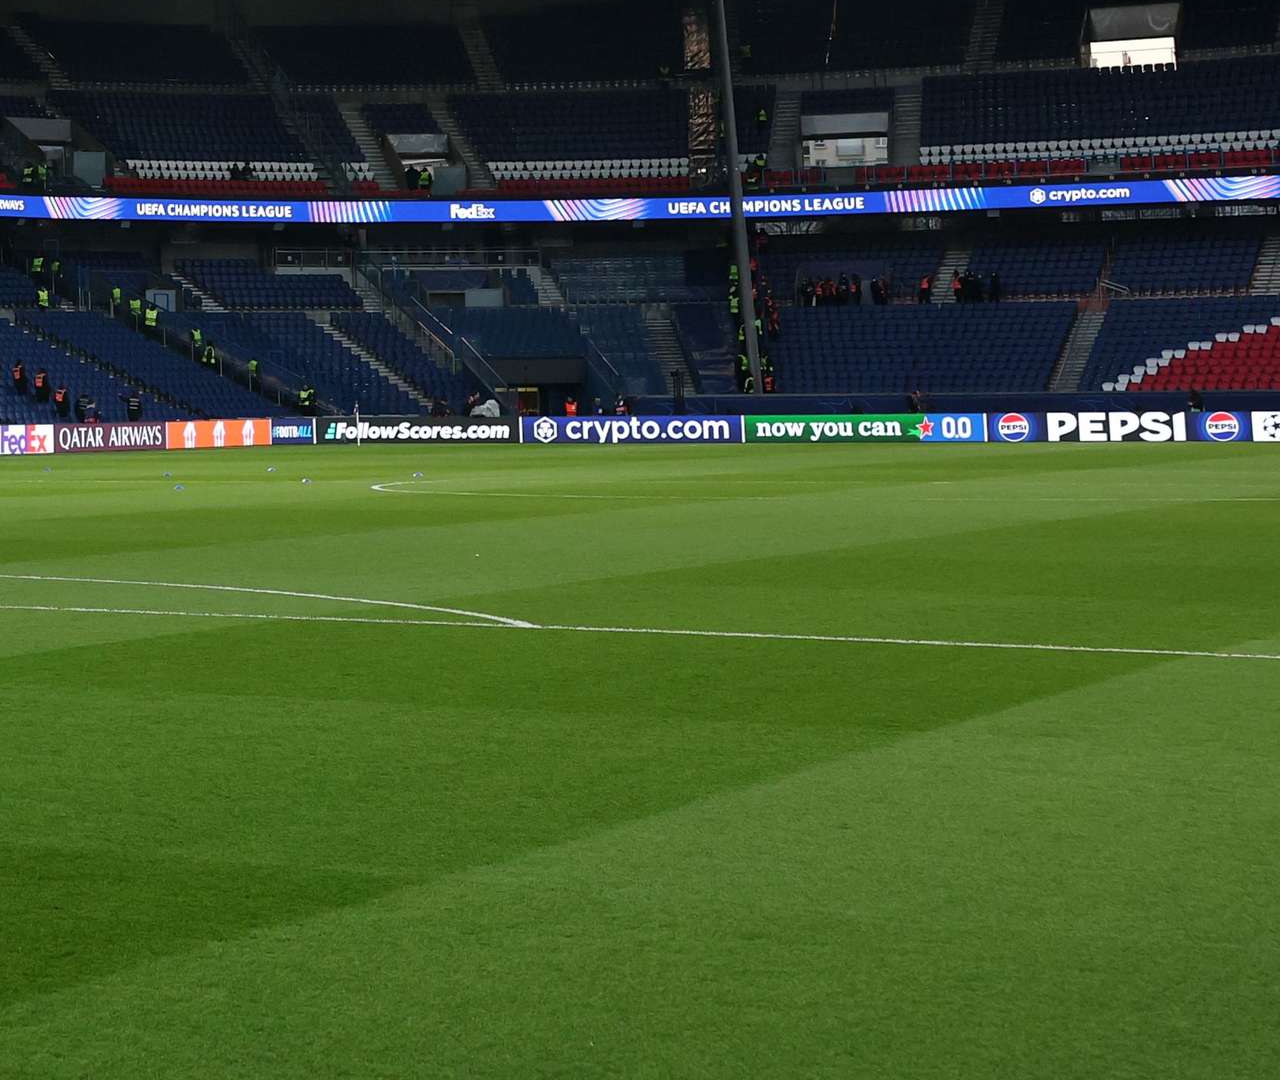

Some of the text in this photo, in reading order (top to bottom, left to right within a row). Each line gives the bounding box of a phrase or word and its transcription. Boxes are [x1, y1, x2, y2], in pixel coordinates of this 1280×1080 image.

[1048, 187, 1130, 203] crypto.com
[136, 203, 292, 219] UEFA CHAMPIONS LEAGUE
[450, 203, 496, 220] FedEx
[668, 196, 865, 215] UEFA CHMPIONS LEAGUE
[335, 422, 510, 440] FollowScores.com
[565, 416, 730, 444] crypto.com
[755, 421, 902, 442] now you can
[941, 416, 972, 439] 0.0
[1000, 424, 1027, 432] PEPSI
[1046, 411, 1187, 442] PEPSI
[1208, 423, 1237, 431] PEPSI
[0, 423, 47, 455] FedEx
[59, 425, 162, 450] QATAR AIRWAYS
